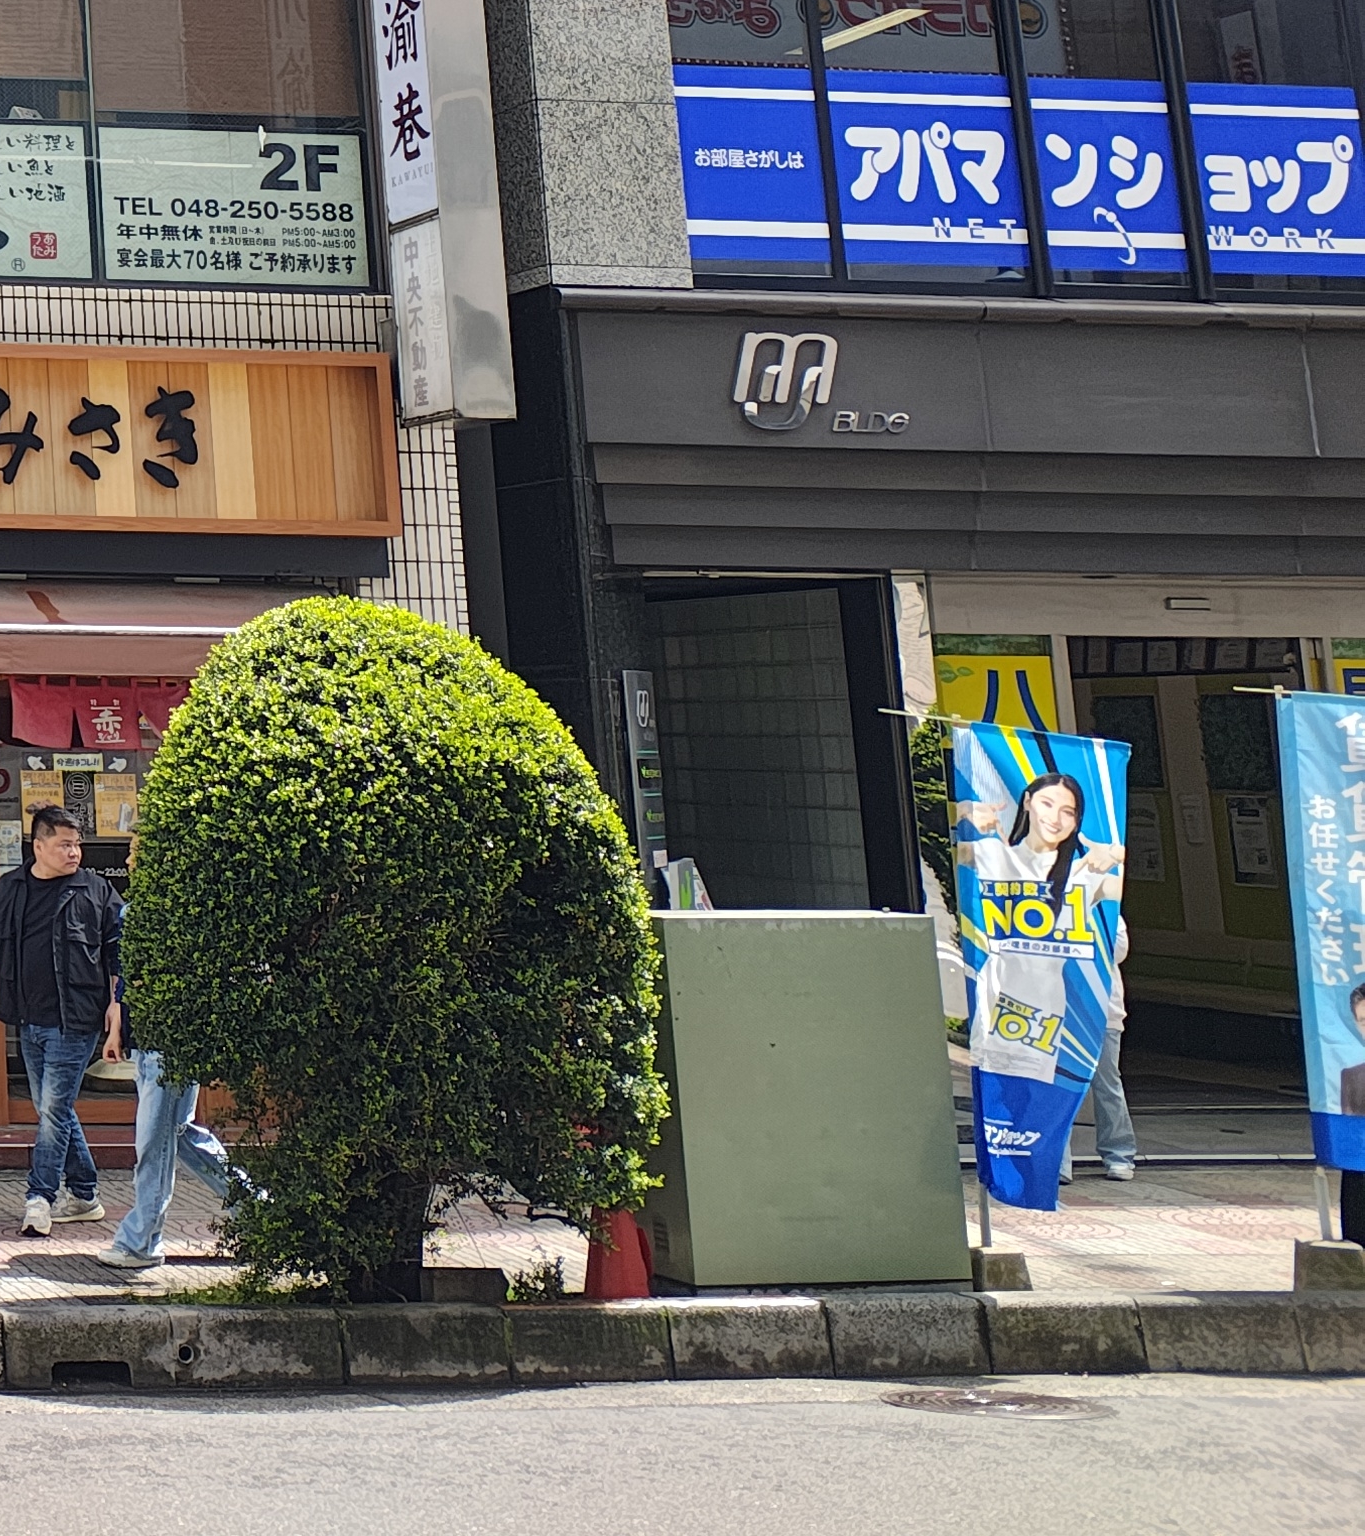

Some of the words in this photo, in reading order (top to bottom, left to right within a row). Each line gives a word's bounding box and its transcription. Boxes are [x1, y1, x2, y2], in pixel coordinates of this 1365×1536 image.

[259, 142, 340, 192] 2F
[694, 148, 805, 170] お部屋さがしは
[844, 121, 1354, 214] アパマンショップ
[114, 197, 163, 216] TEL
[170, 198, 354, 223] 048-250-5588
[116, 224, 203, 242] 年中無休
[933, 217, 1016, 241] NET
[1209, 226, 1336, 250] WORK
[116, 248, 243, 270] 宴会最大70名様
[249, 251, 357, 275] ご予約承ります
[403, 236, 430, 408] 中央不動産
[833, 411, 909, 433] BLDG
[1309, 794, 1350, 987] お任せください
[982, 885, 1095, 943] NO.1
